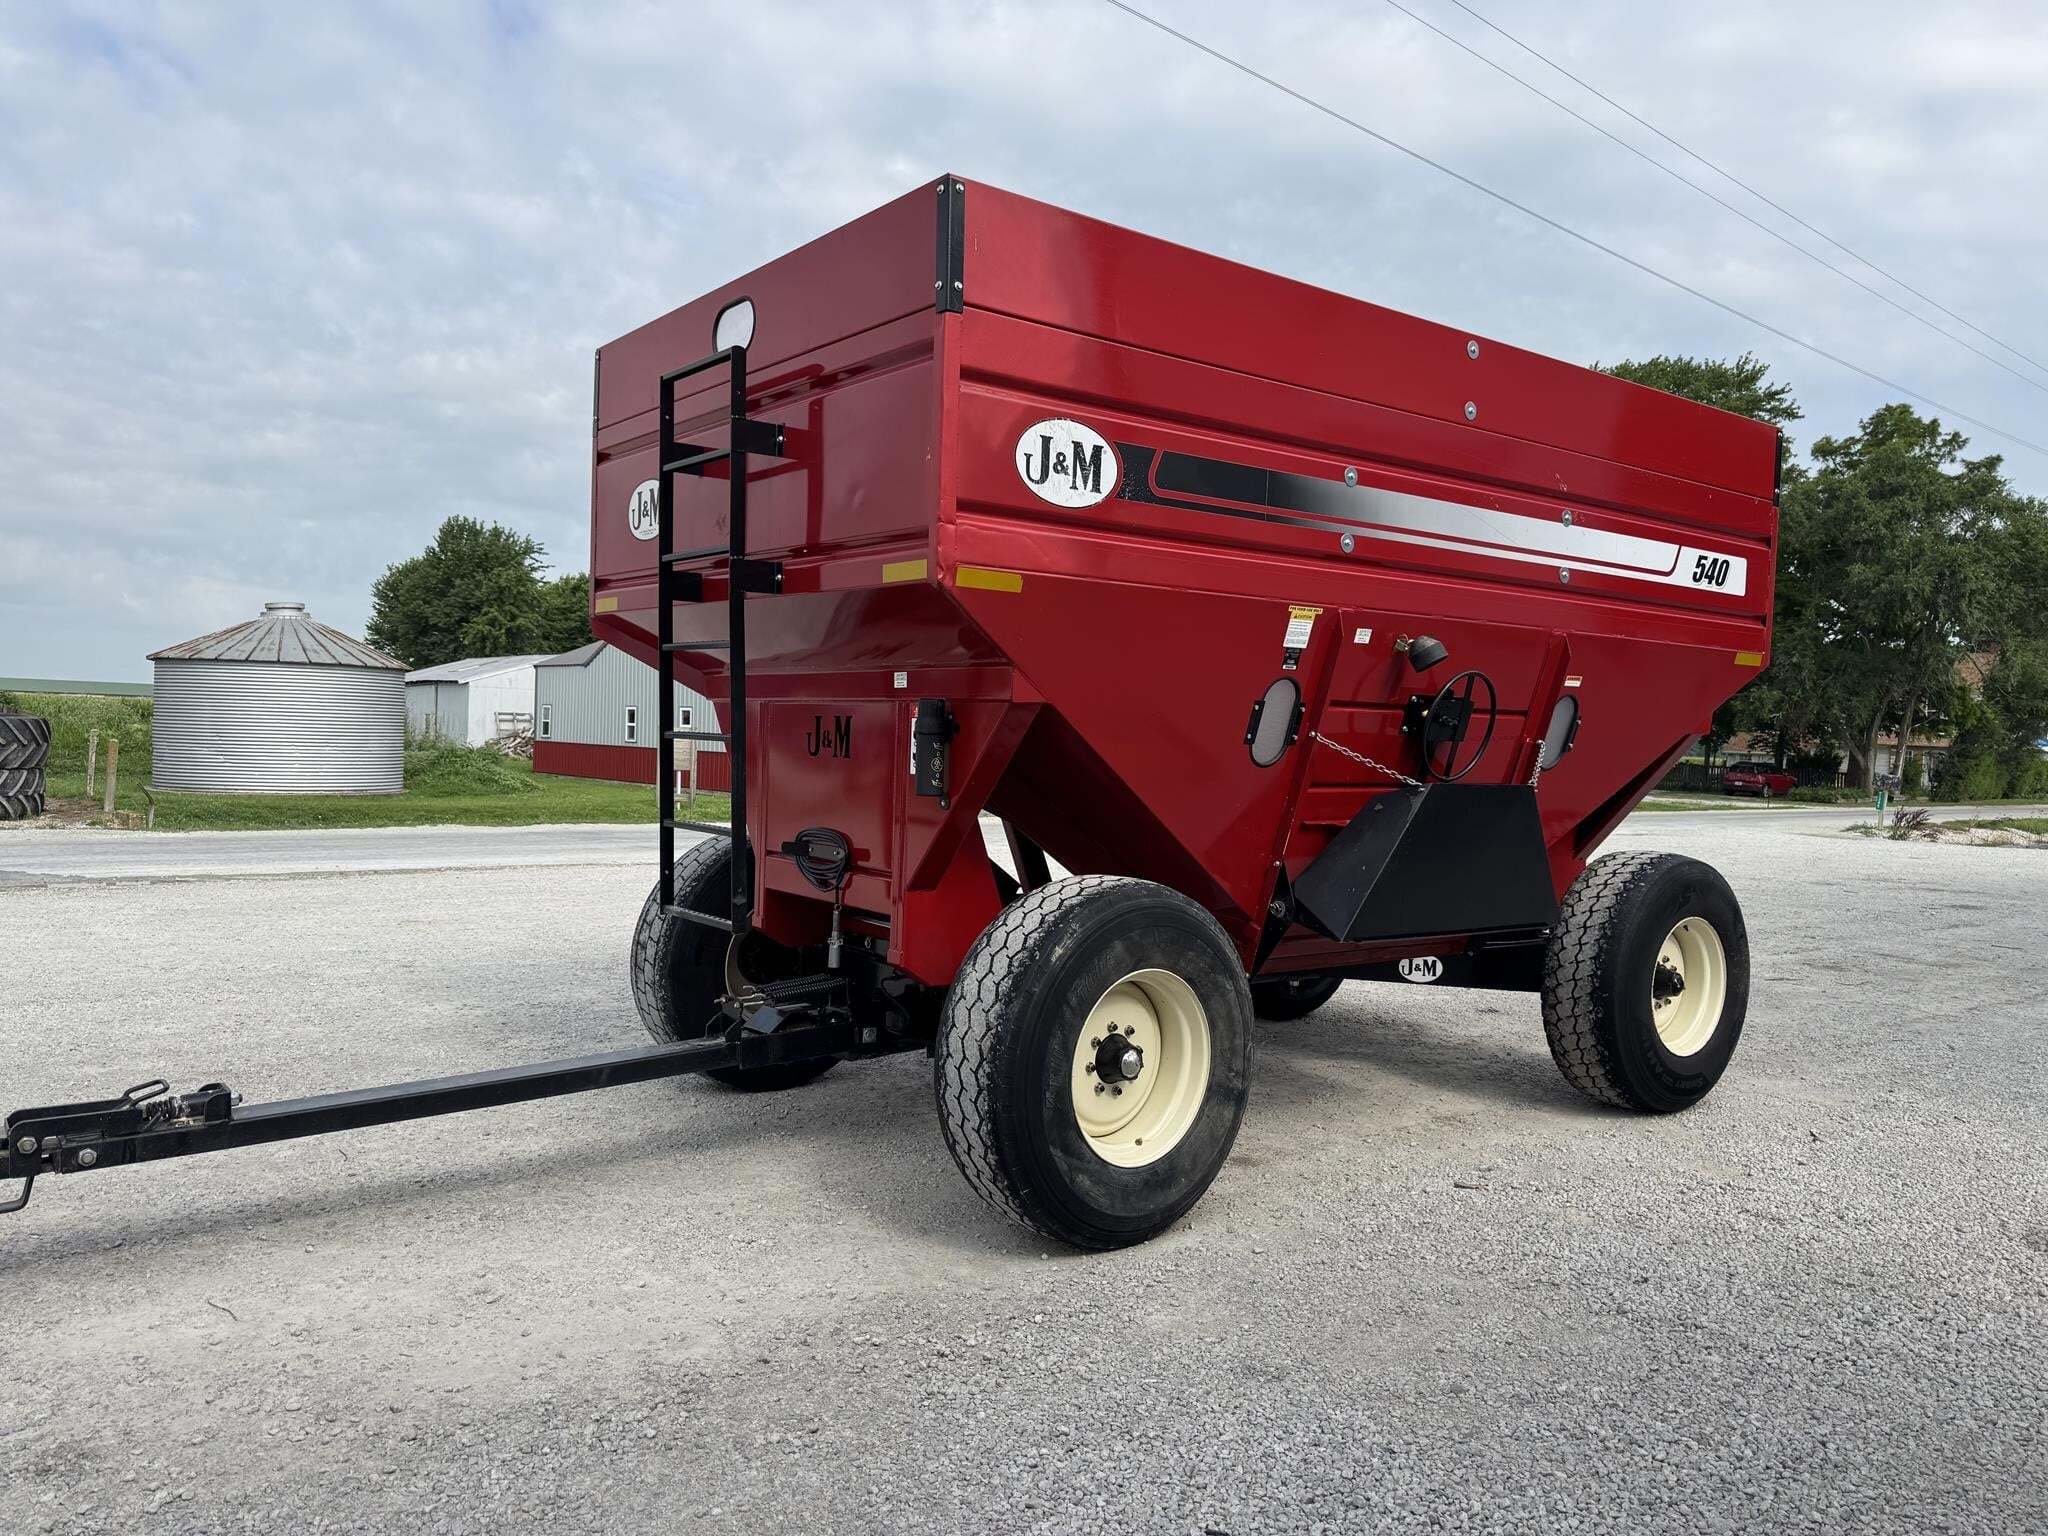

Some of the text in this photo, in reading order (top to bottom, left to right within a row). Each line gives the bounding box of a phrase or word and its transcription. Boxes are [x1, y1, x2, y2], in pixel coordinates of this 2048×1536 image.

[1024, 434, 1104, 494] J&M
[1692, 554, 1730, 587] 540
[806, 715, 853, 758] J&M
[1401, 958, 1437, 977] J&M
